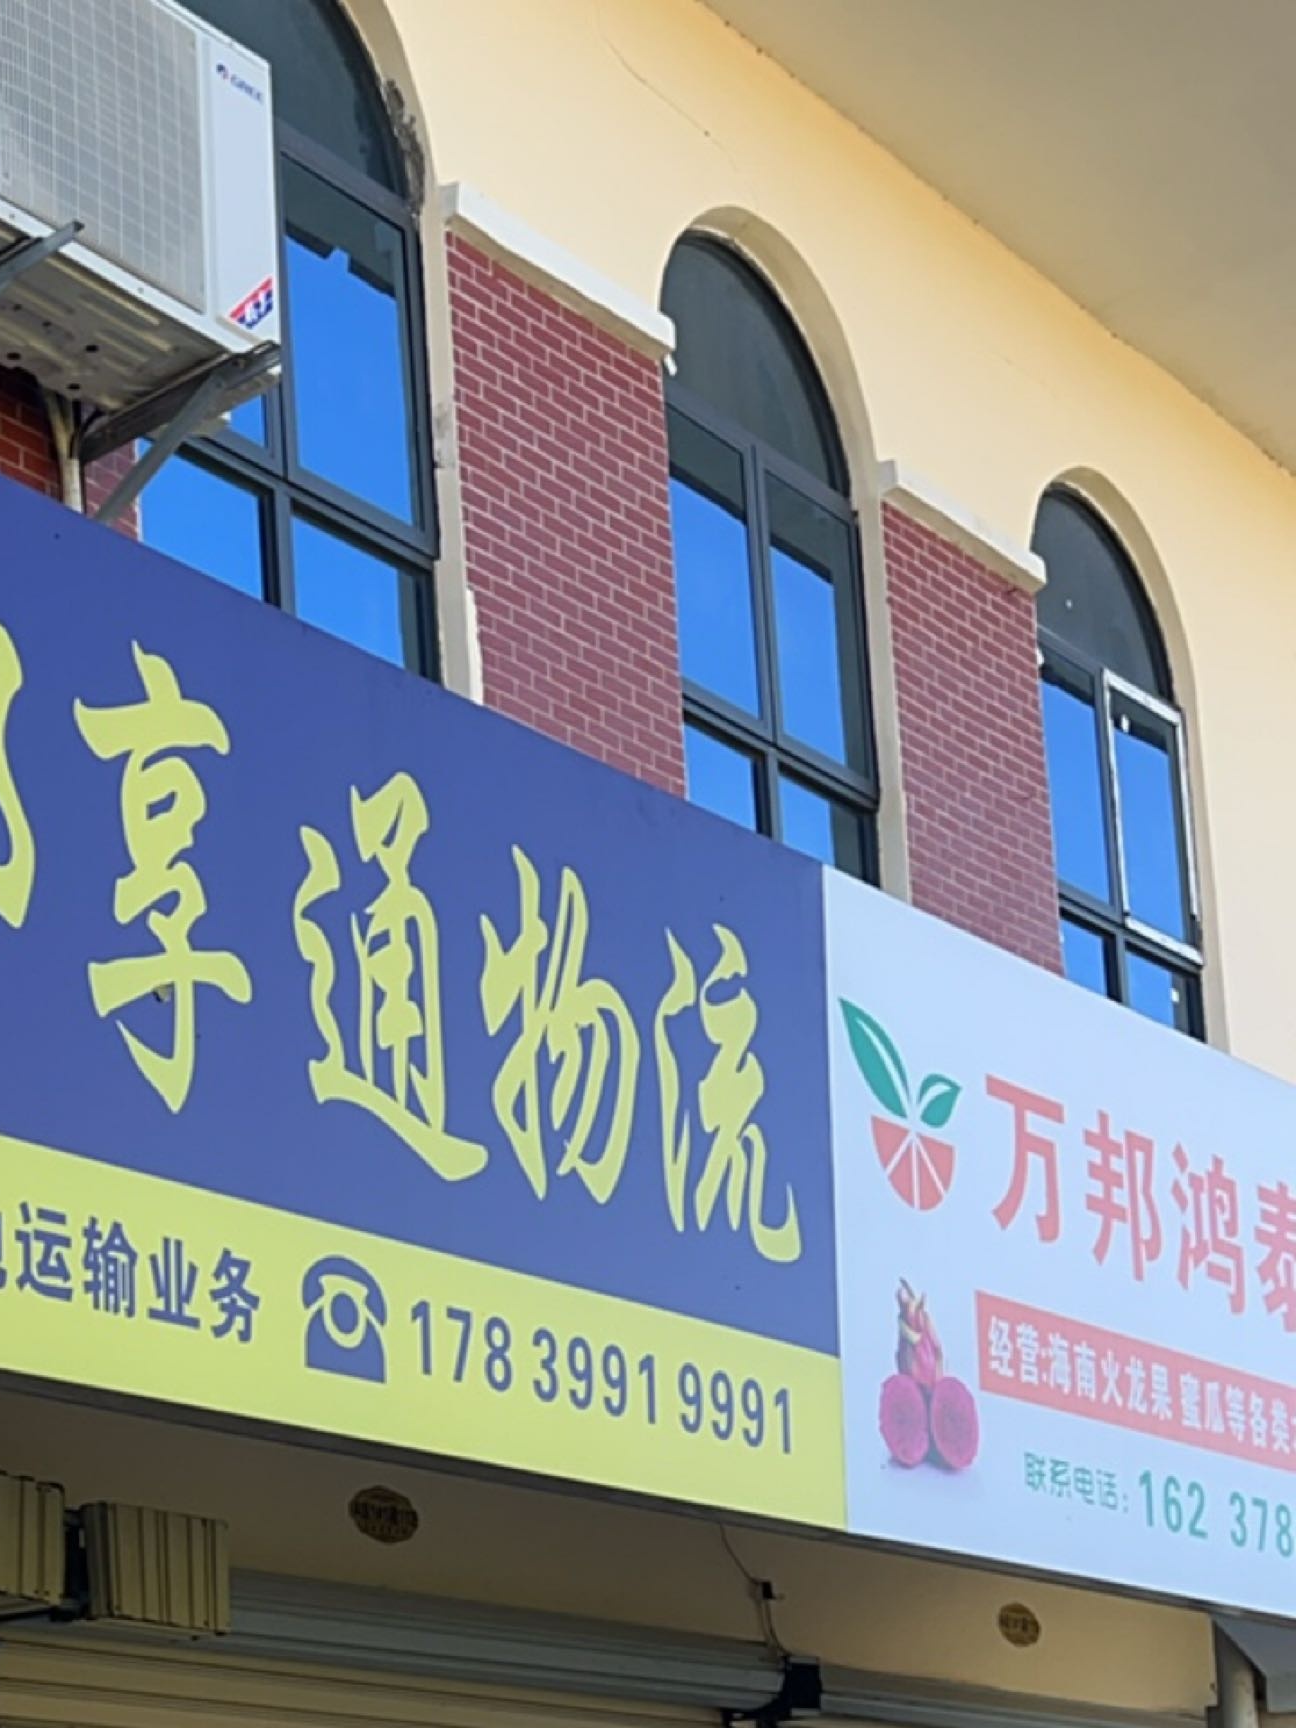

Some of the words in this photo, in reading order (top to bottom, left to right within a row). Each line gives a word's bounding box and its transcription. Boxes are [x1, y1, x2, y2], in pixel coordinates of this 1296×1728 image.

[410, 1300, 512, 1392] 178
[531, 1328, 657, 1424] 3991
[677, 1362, 791, 1454] 9991
[1179, 1371, 1296, 1455] 蜜瓜等各类
[1138, 1469, 1208, 1540] 162
[1229, 1490, 1295, 1558] 378
